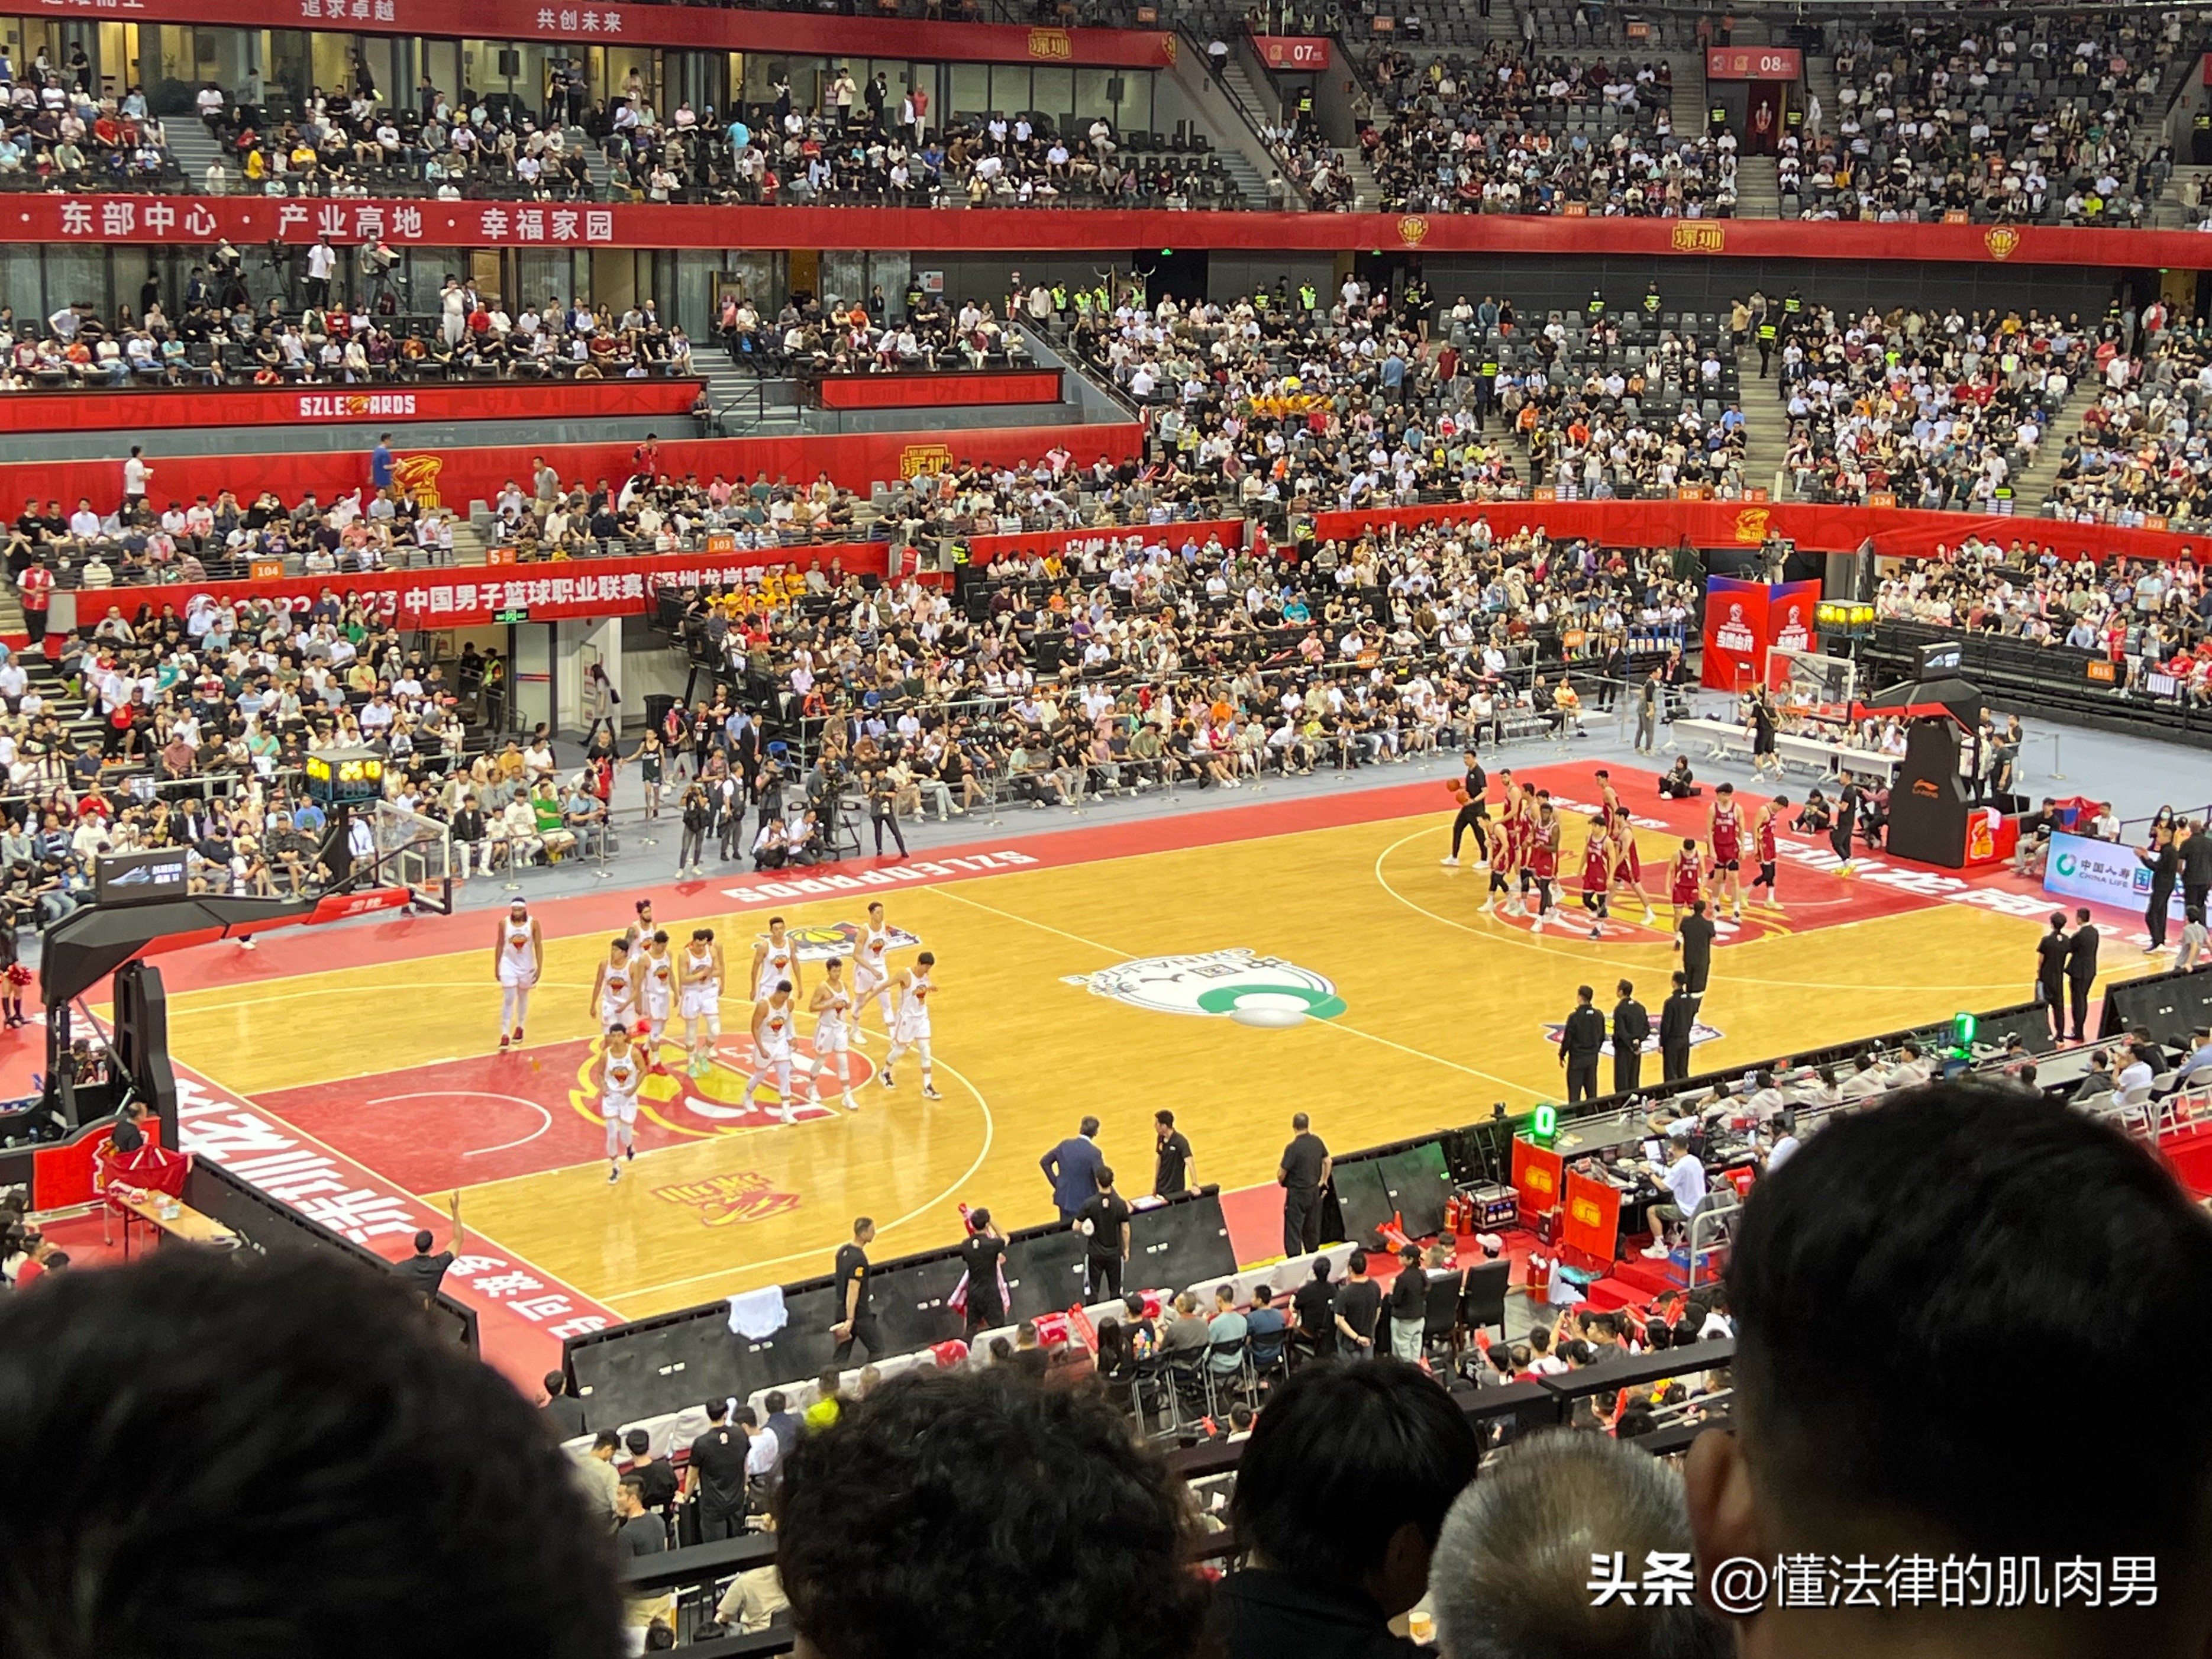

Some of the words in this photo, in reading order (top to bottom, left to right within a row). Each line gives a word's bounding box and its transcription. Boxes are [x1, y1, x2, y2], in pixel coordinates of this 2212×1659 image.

[301, 0, 396, 21] 追求卓越
[537, 9, 622, 33] 共创未来
[1294, 45, 1313, 60] 07
[1761, 56, 1781, 71] 08
[62, 202, 217, 236] 东部中心
[279, 204, 423, 238] 产业高地
[481, 208, 613, 241] 幸福家园
[1873, 498, 1891, 507] 124
[712, 540, 731, 550] 103
[490, 550, 500, 565] 5
[257, 566, 279, 577] 104
[721, 850, 1041, 903] SZLEOPARDS
[2080, 859, 2130, 880] 中国人寿
[1535, 1105, 1555, 1134] 0
